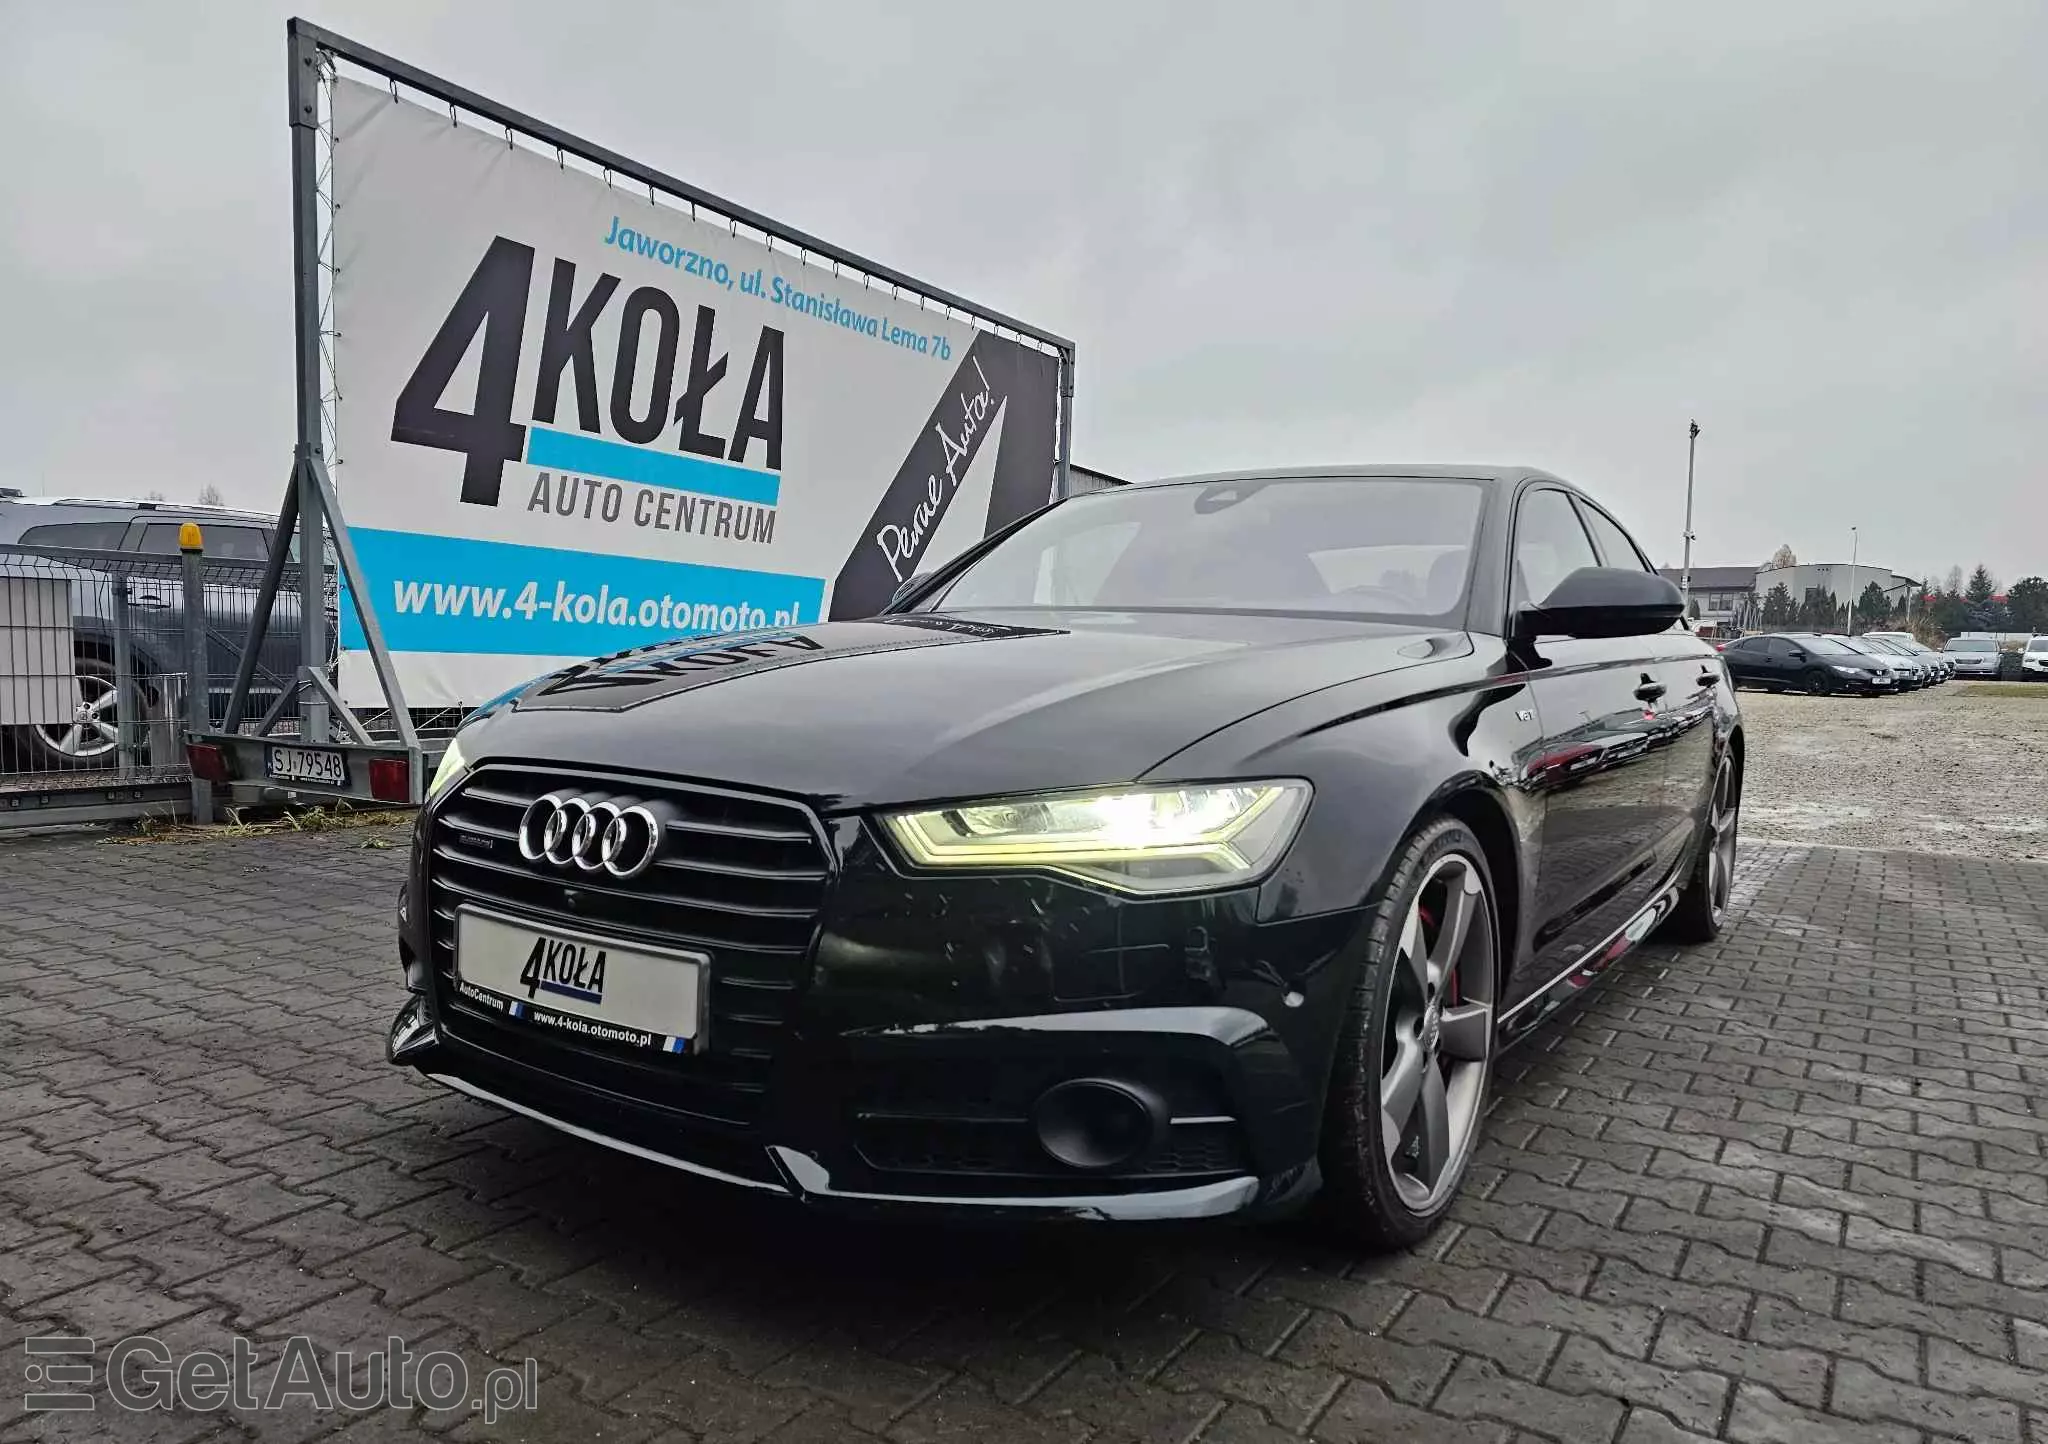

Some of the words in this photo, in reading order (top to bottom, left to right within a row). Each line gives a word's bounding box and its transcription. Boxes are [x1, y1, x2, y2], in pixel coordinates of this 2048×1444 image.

[604, 215, 735, 291] Jaworzno,
[739, 270, 767, 299] ul.
[770, 275, 879, 338] Stanisława
[881, 316, 928, 353] Lema
[931, 335, 951, 361] 7b
[527, 471, 623, 523] AUTO
[633, 488, 777, 544] CENTRUM
[459, 983, 504, 1011] AutoCentrum
[533, 1010, 652, 1048] www.4-kola.otomoto.pl
